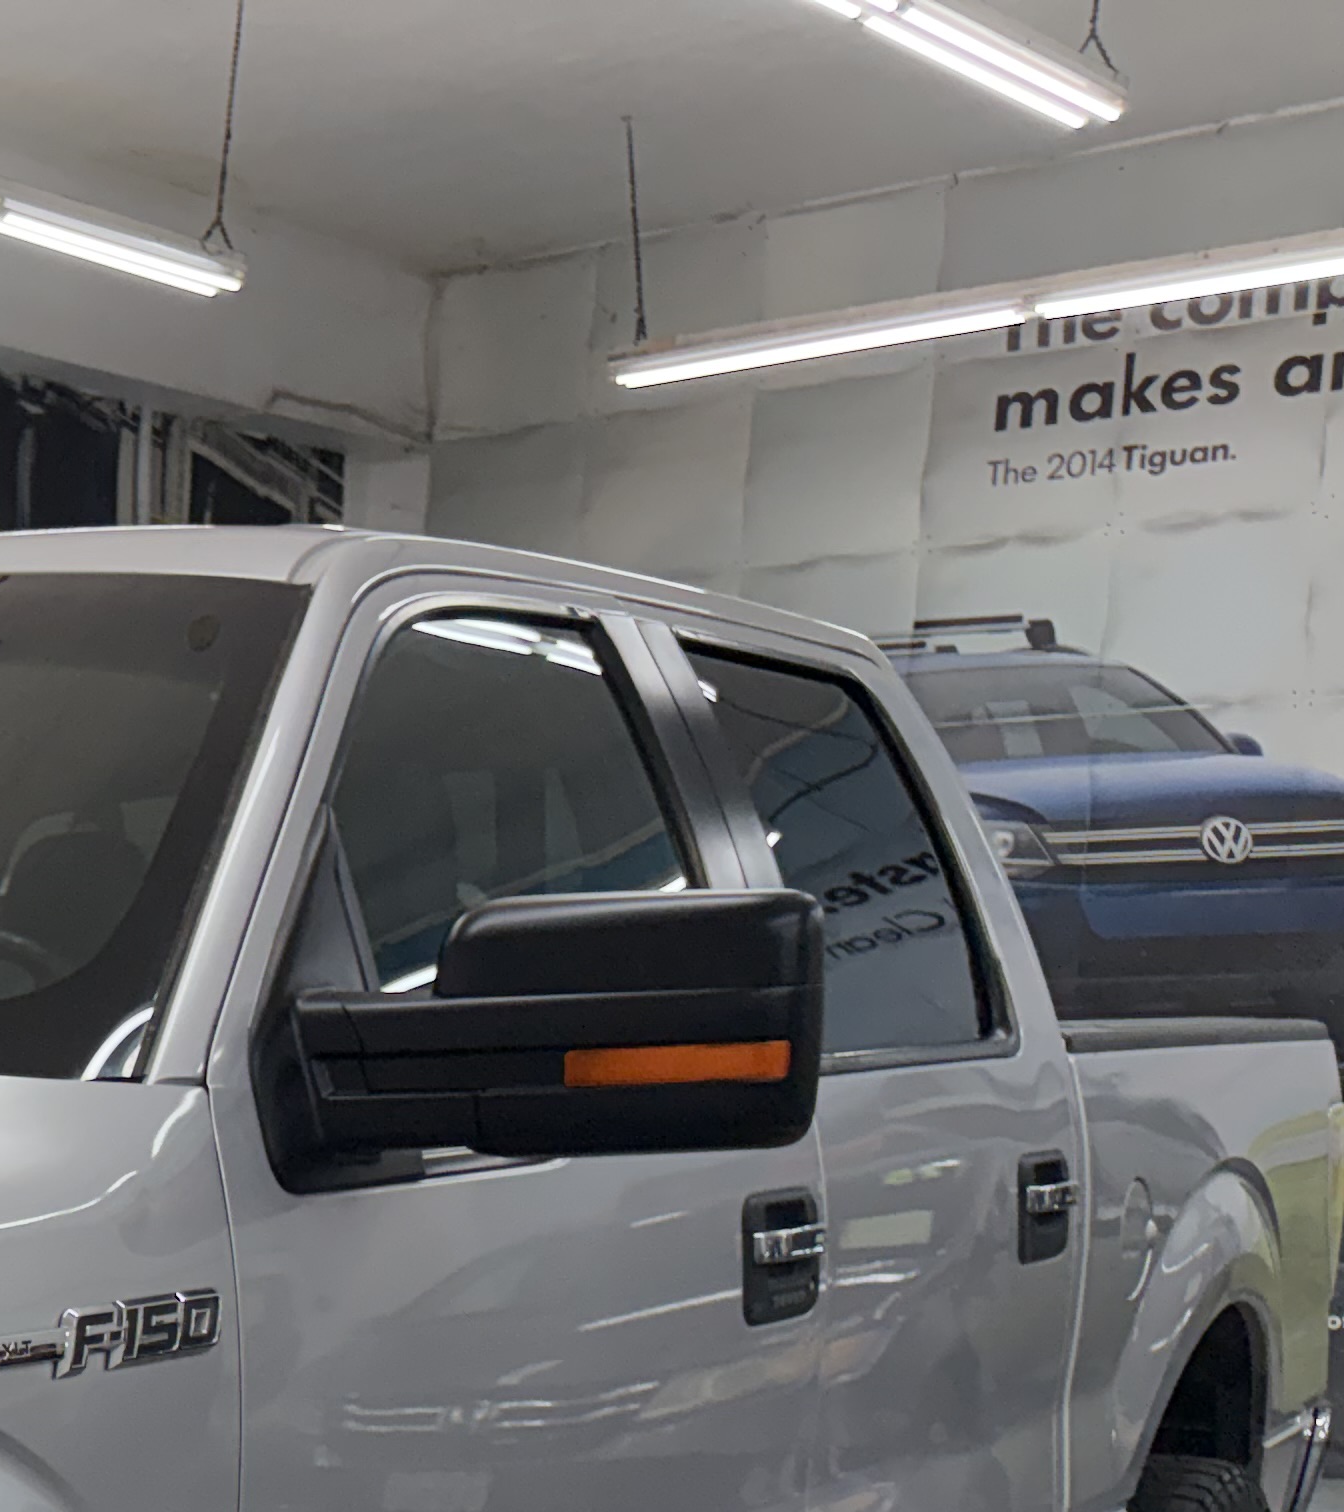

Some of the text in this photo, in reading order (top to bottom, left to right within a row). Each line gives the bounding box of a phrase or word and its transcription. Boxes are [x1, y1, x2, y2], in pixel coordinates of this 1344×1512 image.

[994, 352, 1241, 432] makes
[987, 442, 1237, 487] The 2014 Tiguan.
[1202, 816, 1253, 864] VW
[1, 1340, 32, 1359] XLT
